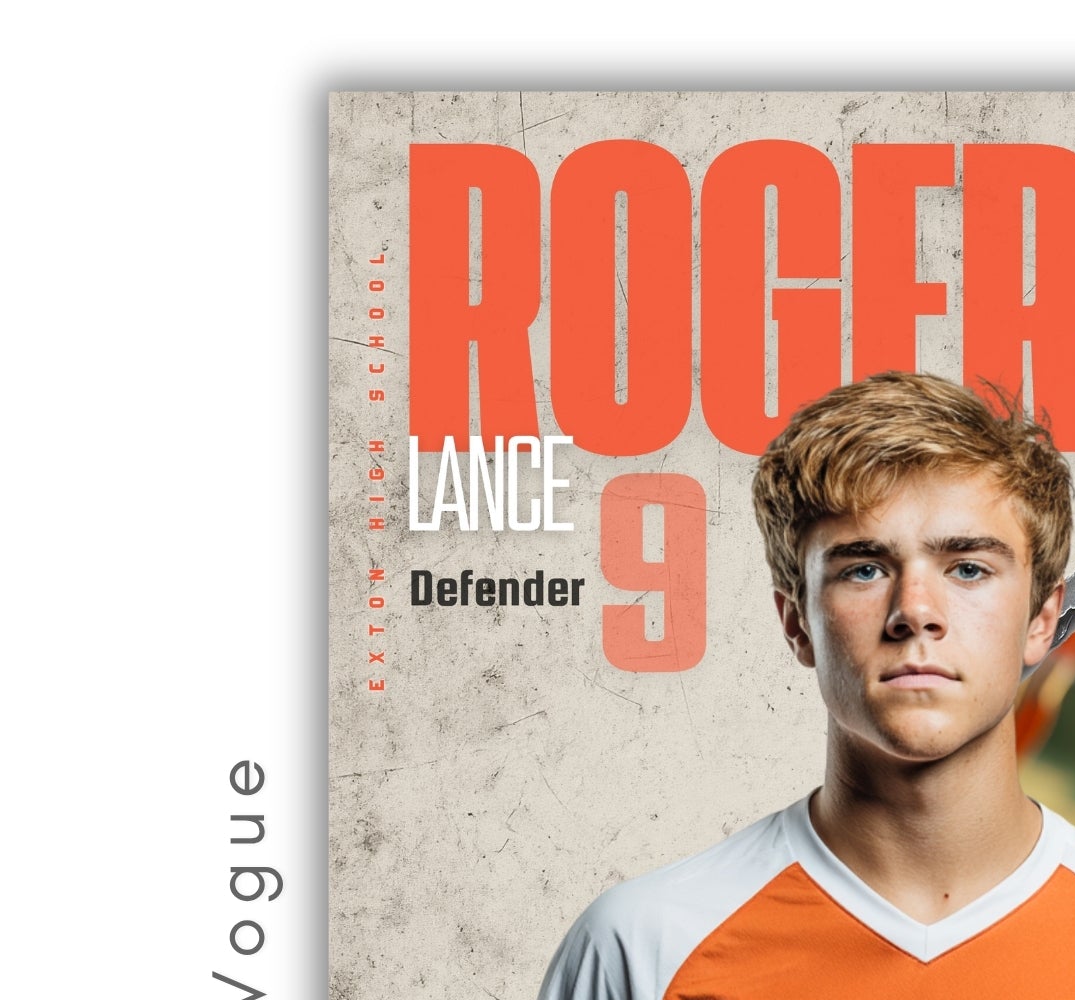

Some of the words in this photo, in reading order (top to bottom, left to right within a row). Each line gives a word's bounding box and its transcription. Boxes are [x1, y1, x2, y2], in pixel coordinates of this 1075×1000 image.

[368, 253, 386, 402] SCHOOL
[368, 440, 386, 531] HIGH
[408, 435, 575, 532] LANCE
[409, 569, 586, 607] Defender
[601, 472, 707, 673] 9
[368, 568, 386, 691] EXTON
